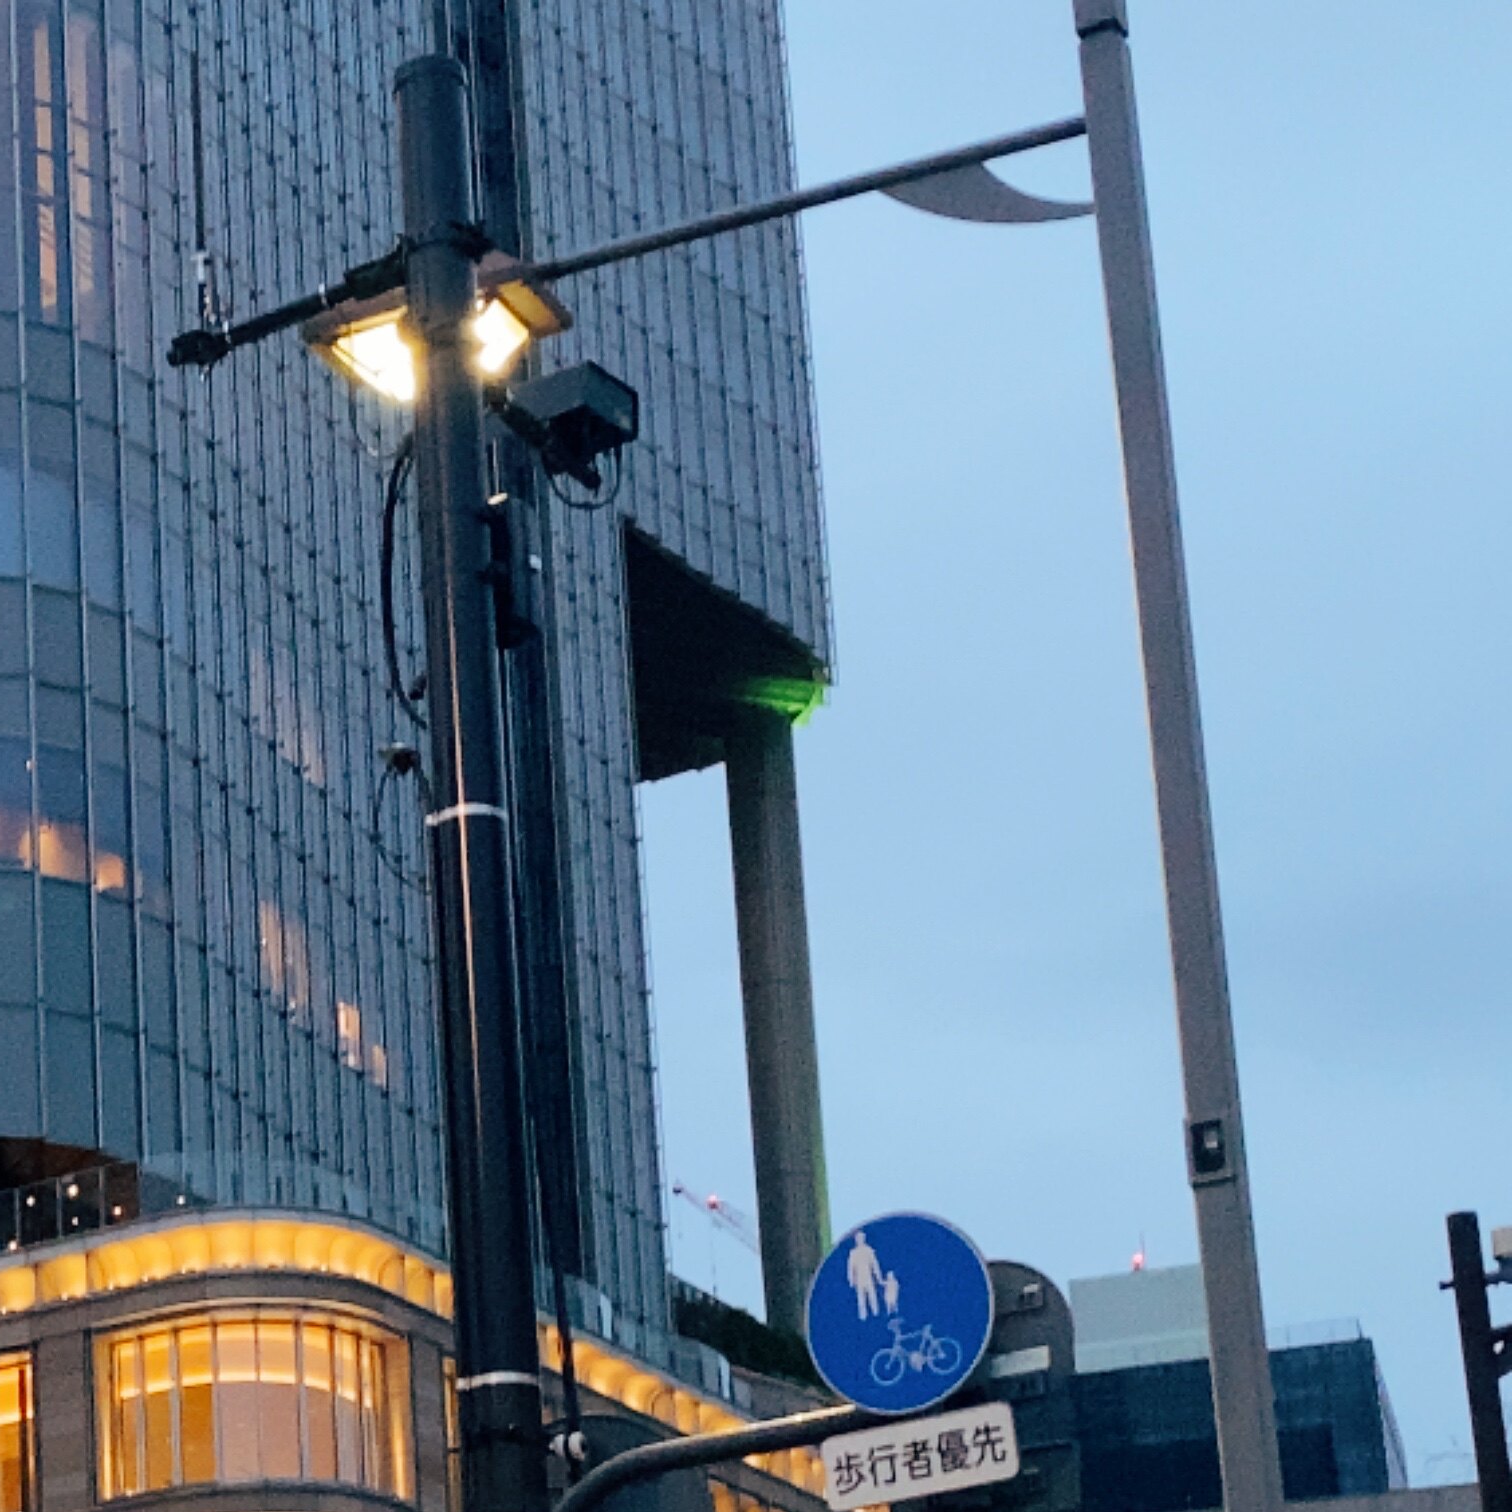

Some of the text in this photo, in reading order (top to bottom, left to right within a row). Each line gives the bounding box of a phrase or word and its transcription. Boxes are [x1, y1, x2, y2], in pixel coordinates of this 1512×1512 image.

[833, 1424, 1008, 1496] 歩行者優先
